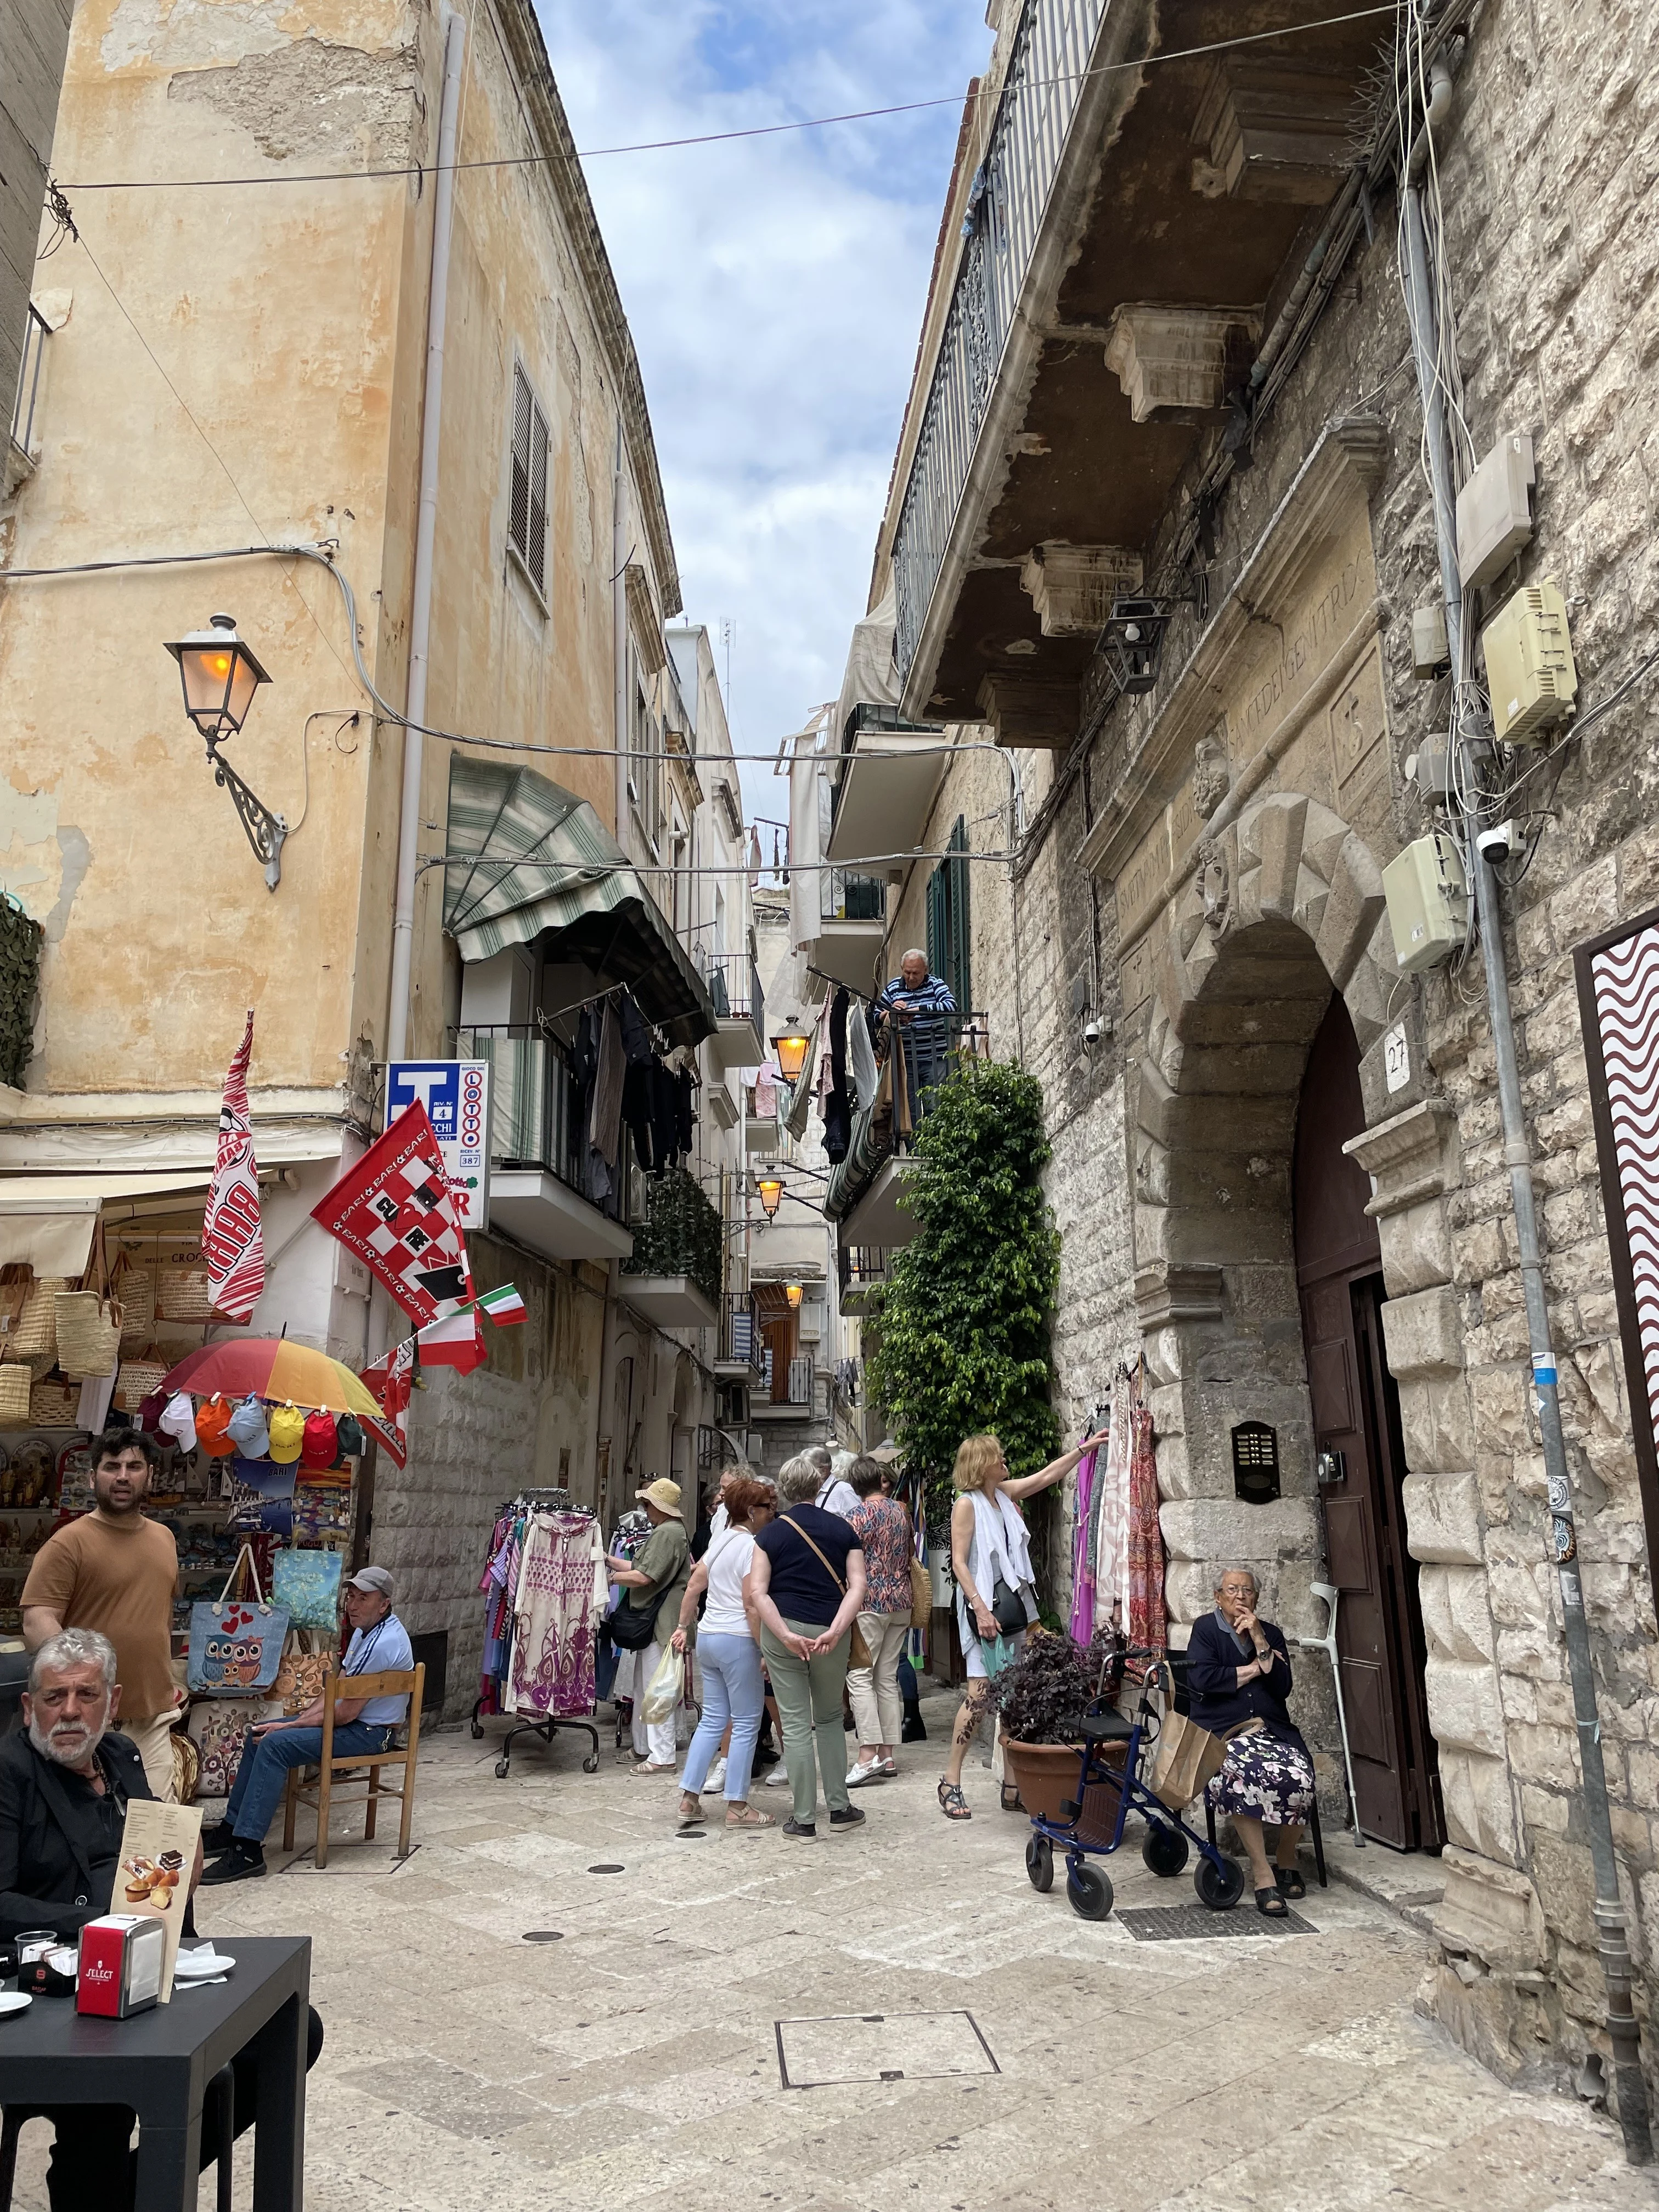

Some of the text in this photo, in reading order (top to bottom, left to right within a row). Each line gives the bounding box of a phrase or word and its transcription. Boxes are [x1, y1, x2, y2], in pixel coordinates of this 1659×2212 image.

[1389, 1038, 1404, 1074] 27
[439, 1109, 447, 1118] 4
[431, 1123, 452, 1133] CCHI
[341, 1128, 428, 1222] BARI BARI BARI
[341, 1228, 369, 1251] BARI
[374, 1257, 399, 1285] BARI
[404, 1293, 430, 1319] BARI
[268, 1467, 287, 1476] BARI
[85, 1968, 114, 1979] SELECT
